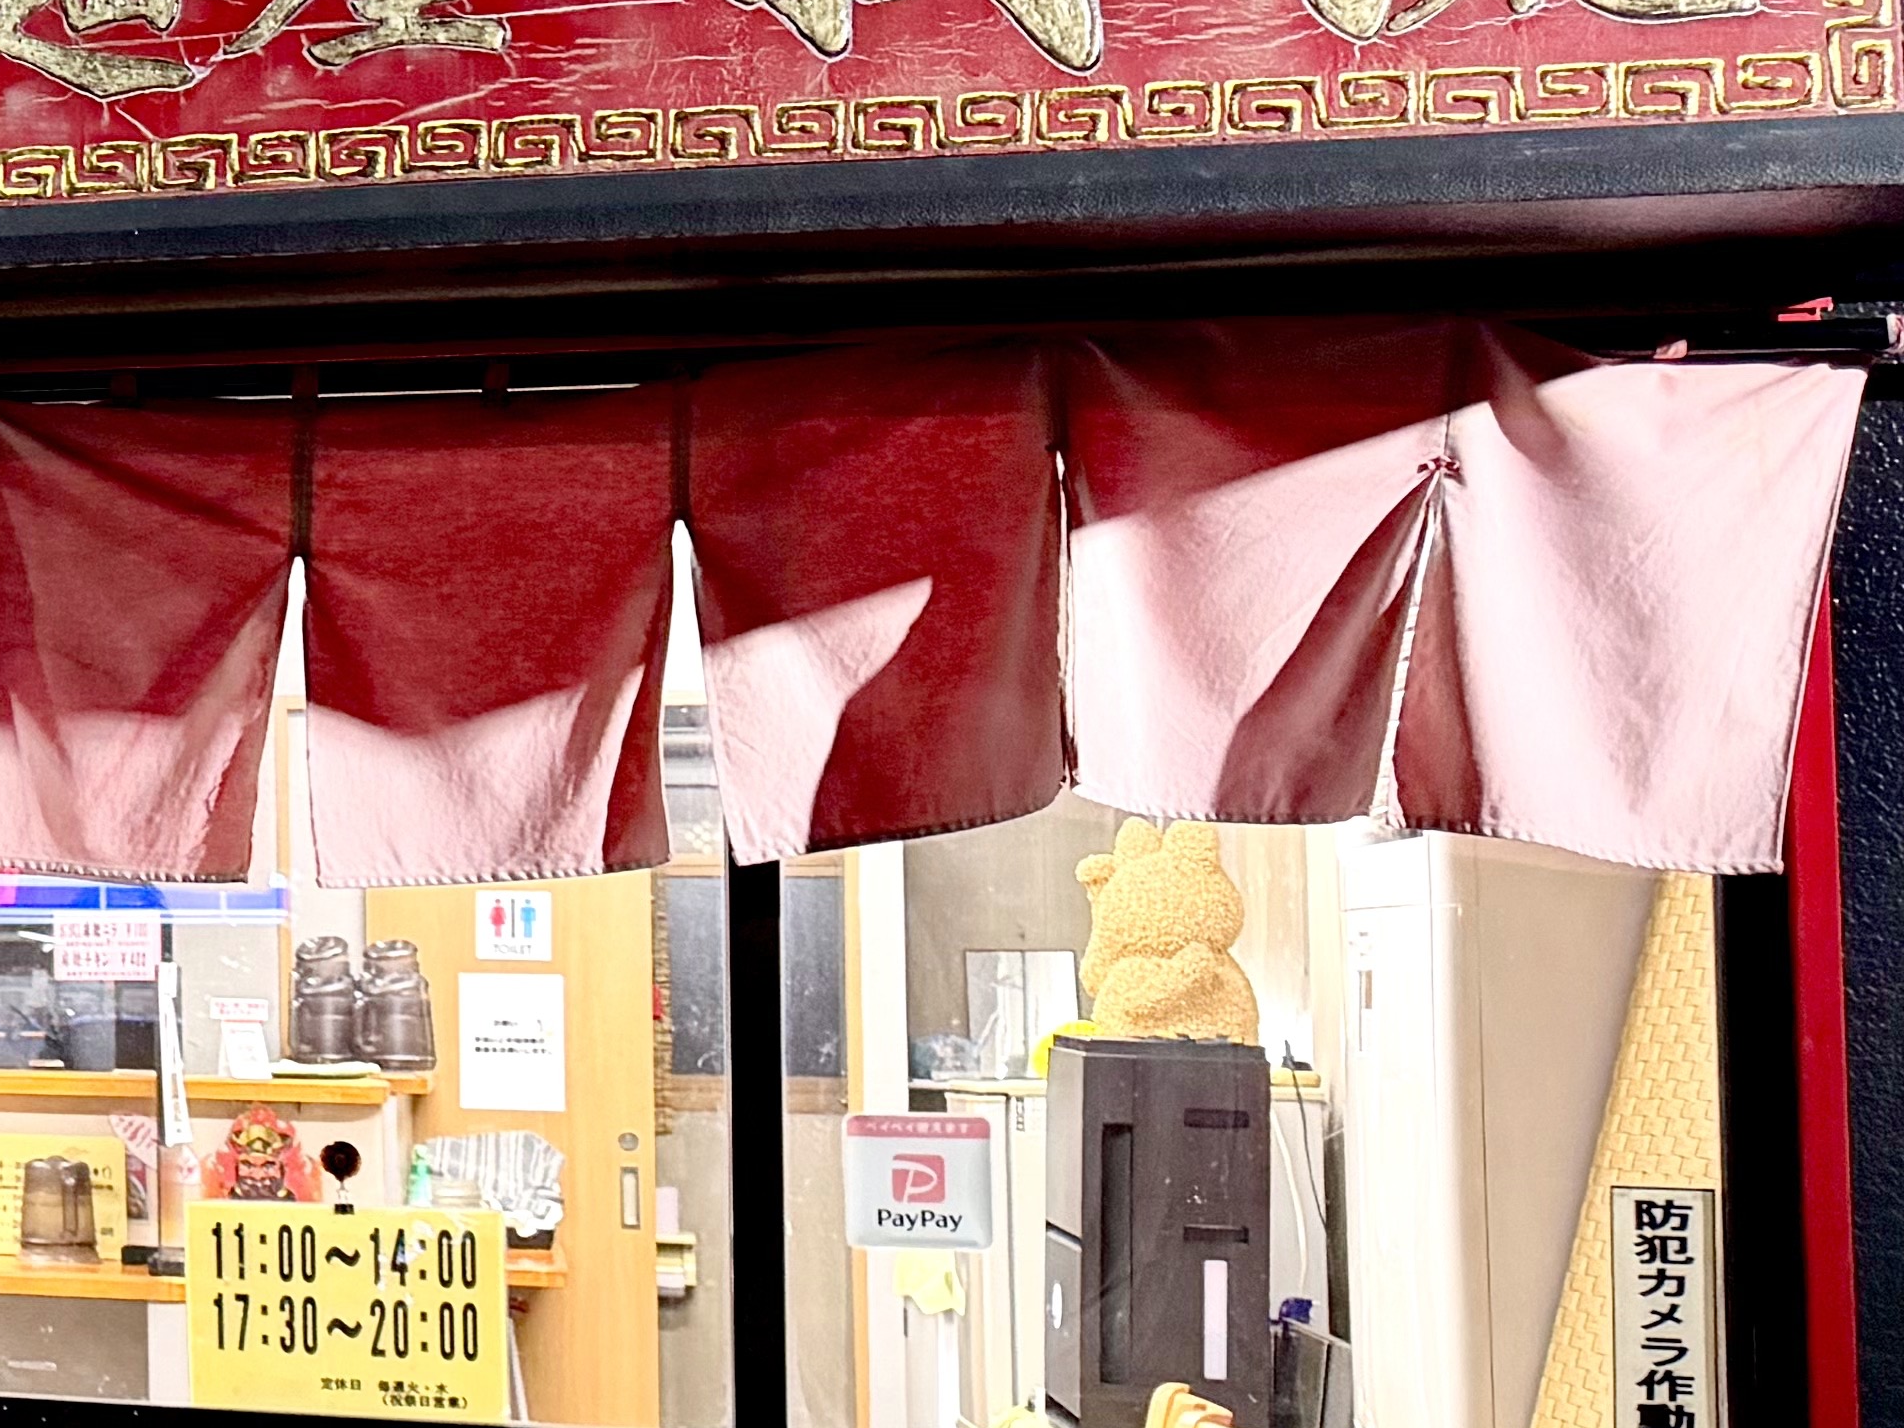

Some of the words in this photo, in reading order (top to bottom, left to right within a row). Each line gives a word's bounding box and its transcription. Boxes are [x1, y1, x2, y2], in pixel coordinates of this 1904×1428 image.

[877, 1208, 963, 1232] PayPay
[320, 1377, 362, 1391] 定休日
